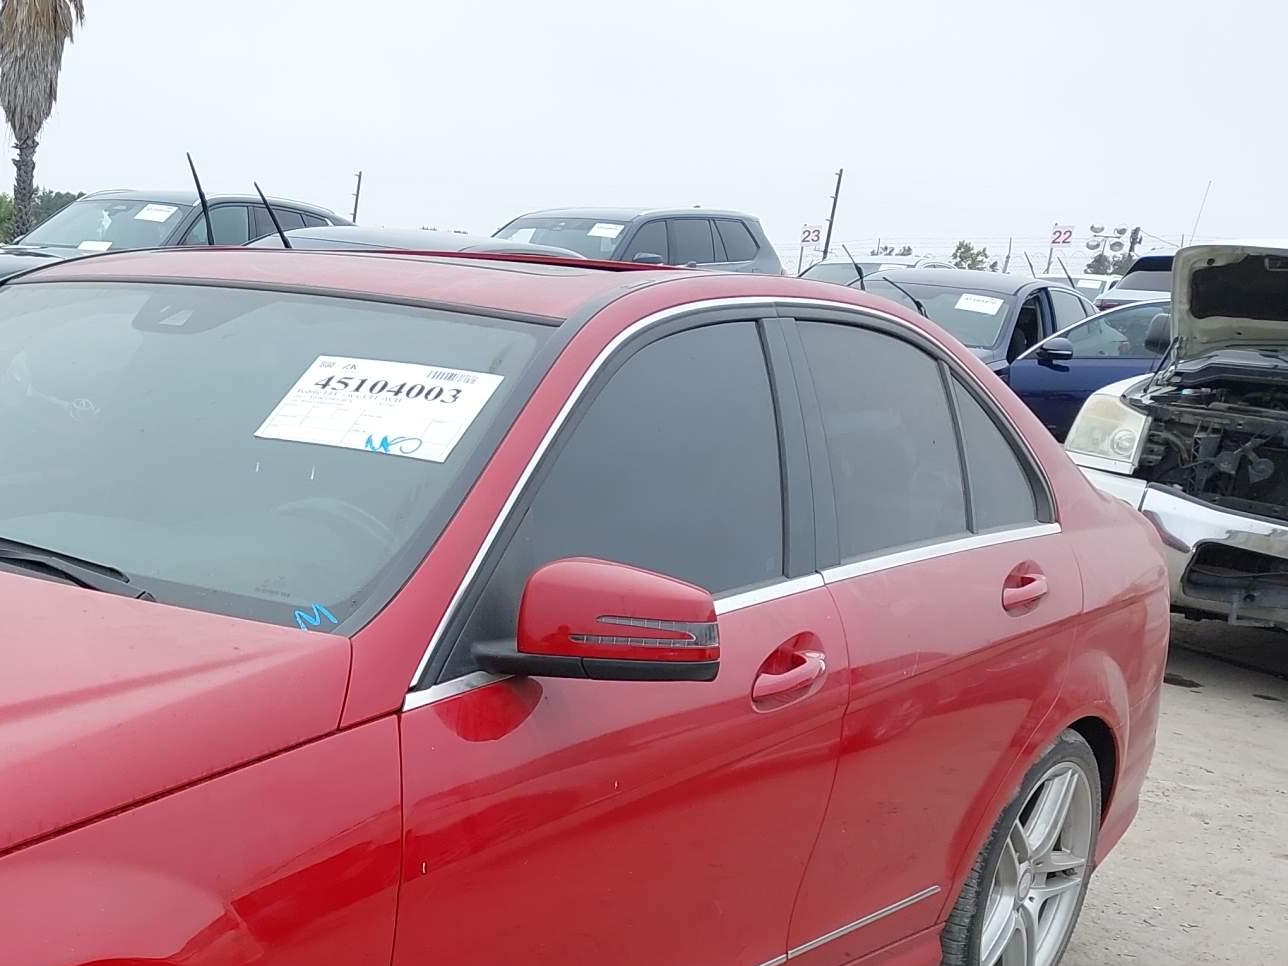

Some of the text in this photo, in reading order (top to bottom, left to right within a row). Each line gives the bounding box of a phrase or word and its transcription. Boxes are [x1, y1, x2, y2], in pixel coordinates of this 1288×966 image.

[801, 229, 821, 242] 23
[1052, 230, 1072, 244] 22
[314, 375, 462, 404] 45104003
